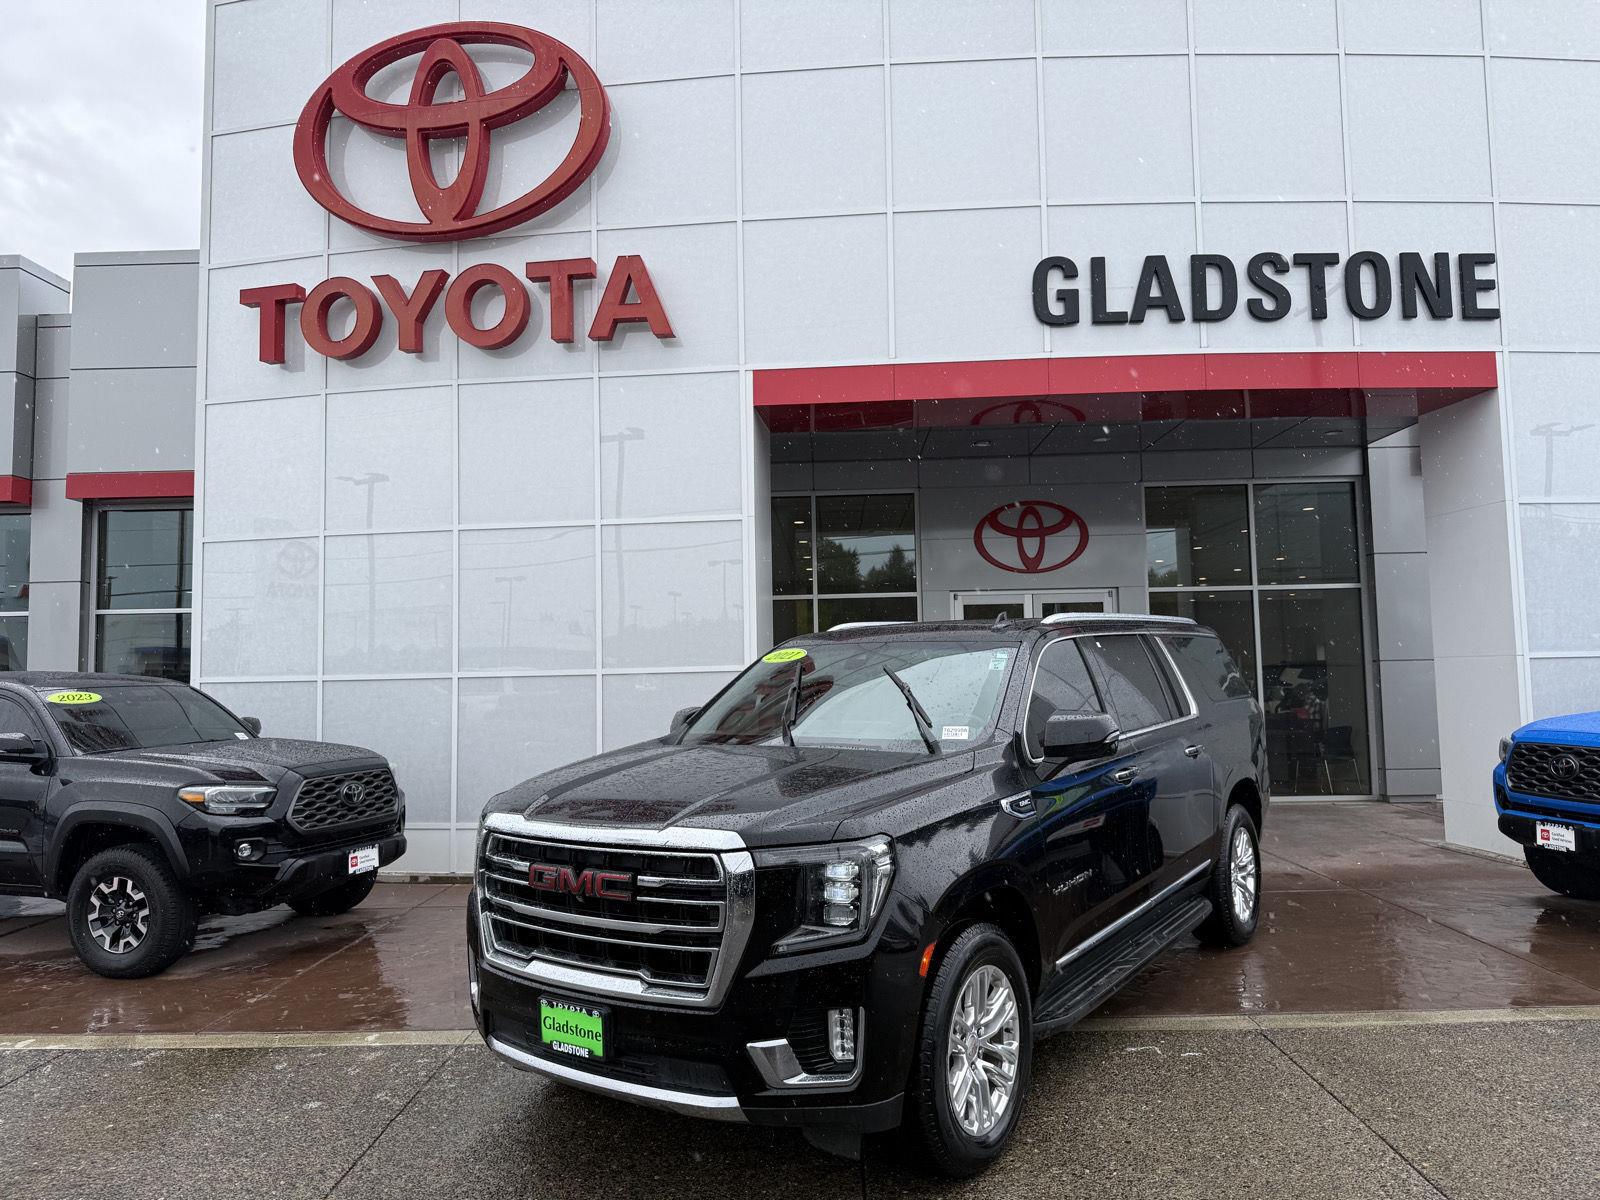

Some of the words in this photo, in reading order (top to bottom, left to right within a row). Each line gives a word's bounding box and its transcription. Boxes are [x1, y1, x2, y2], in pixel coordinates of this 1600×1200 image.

[1032, 251, 1500, 326] GLADSTONE
[240, 254, 676, 365] TOYOTA
[57, 693, 93, 702] 2023
[528, 862, 633, 902] GMC
[552, 1001, 588, 1015] TOYOTA
[543, 1015, 602, 1042] Gladstone
[552, 1040, 590, 1059] GLADSTONE
